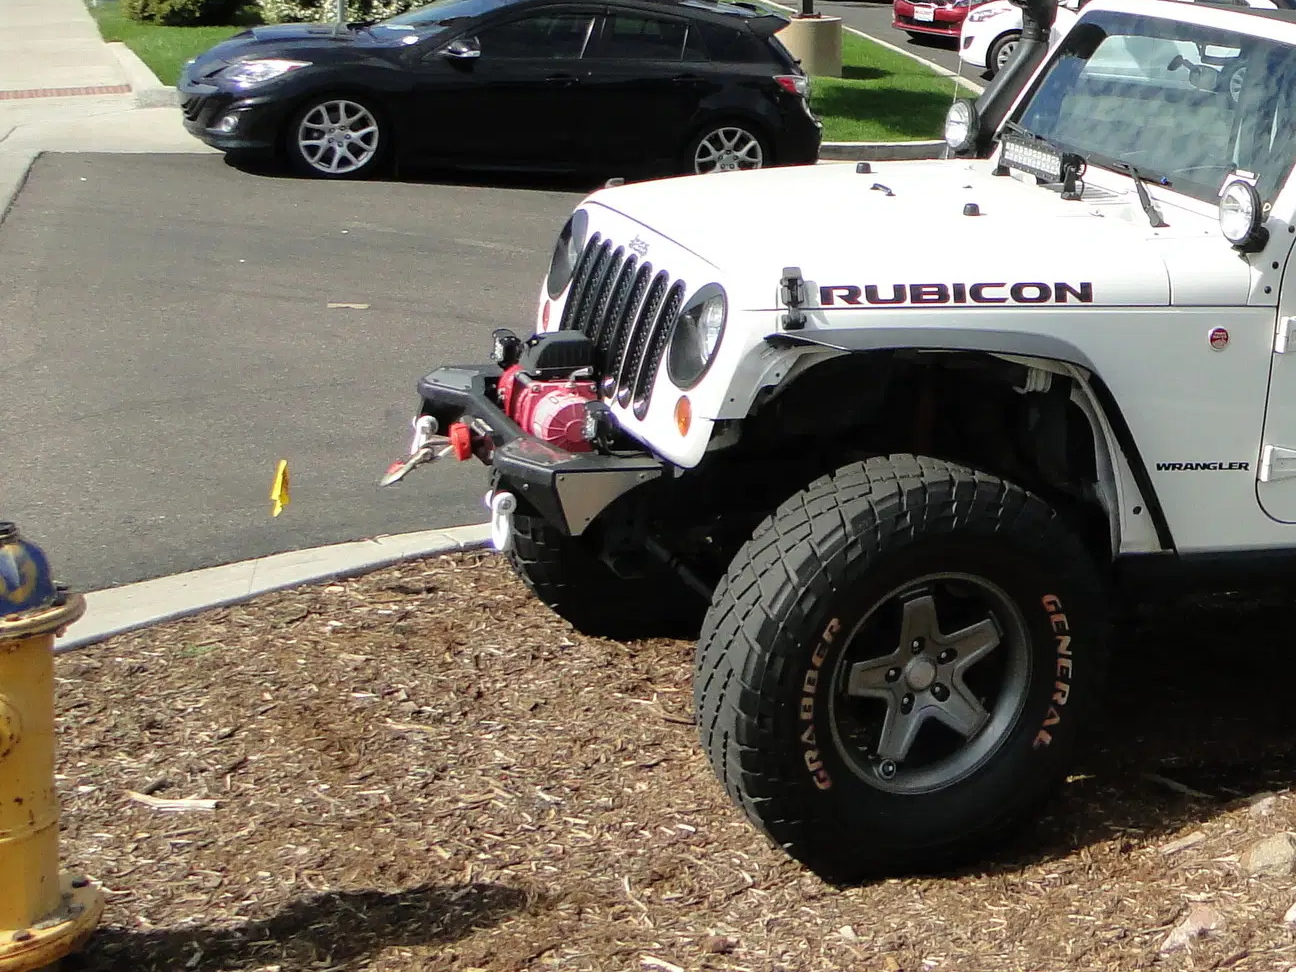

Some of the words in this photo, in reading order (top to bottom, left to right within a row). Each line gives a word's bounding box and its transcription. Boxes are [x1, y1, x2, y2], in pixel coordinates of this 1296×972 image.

[819, 282, 1094, 306] RUBICON
[1156, 462, 1250, 472] WRANGLER
[799, 617, 842, 791] GRABBER
[1032, 593, 1073, 751] GENERAL
